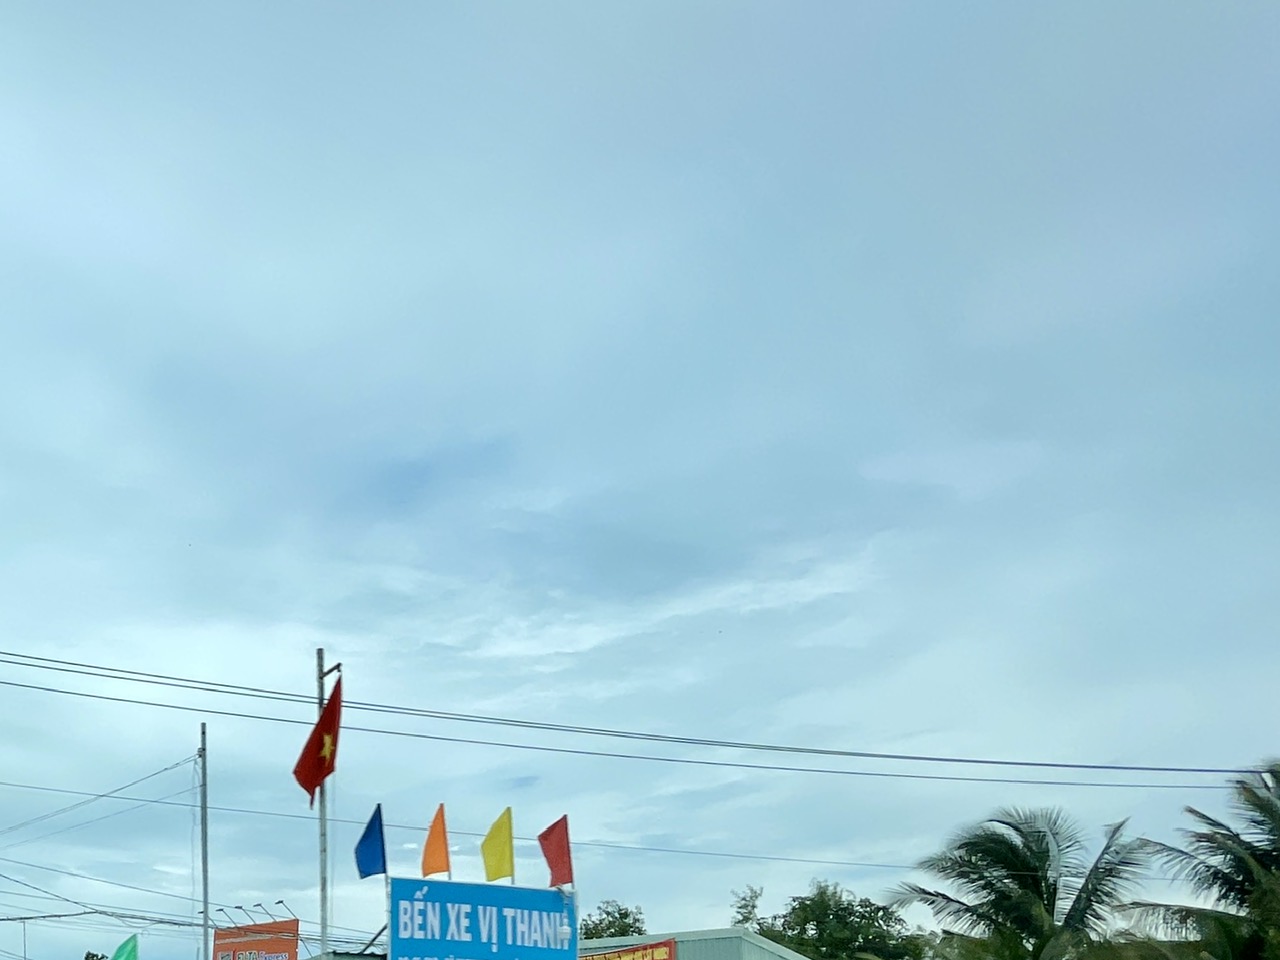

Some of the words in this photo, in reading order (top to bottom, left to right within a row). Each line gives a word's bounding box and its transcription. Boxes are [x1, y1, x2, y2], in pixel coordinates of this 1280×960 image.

[398, 886, 441, 940] BẾN
[445, 902, 473, 942] XE
[477, 905, 498, 953] VỊ
[502, 907, 570, 950] THANH
